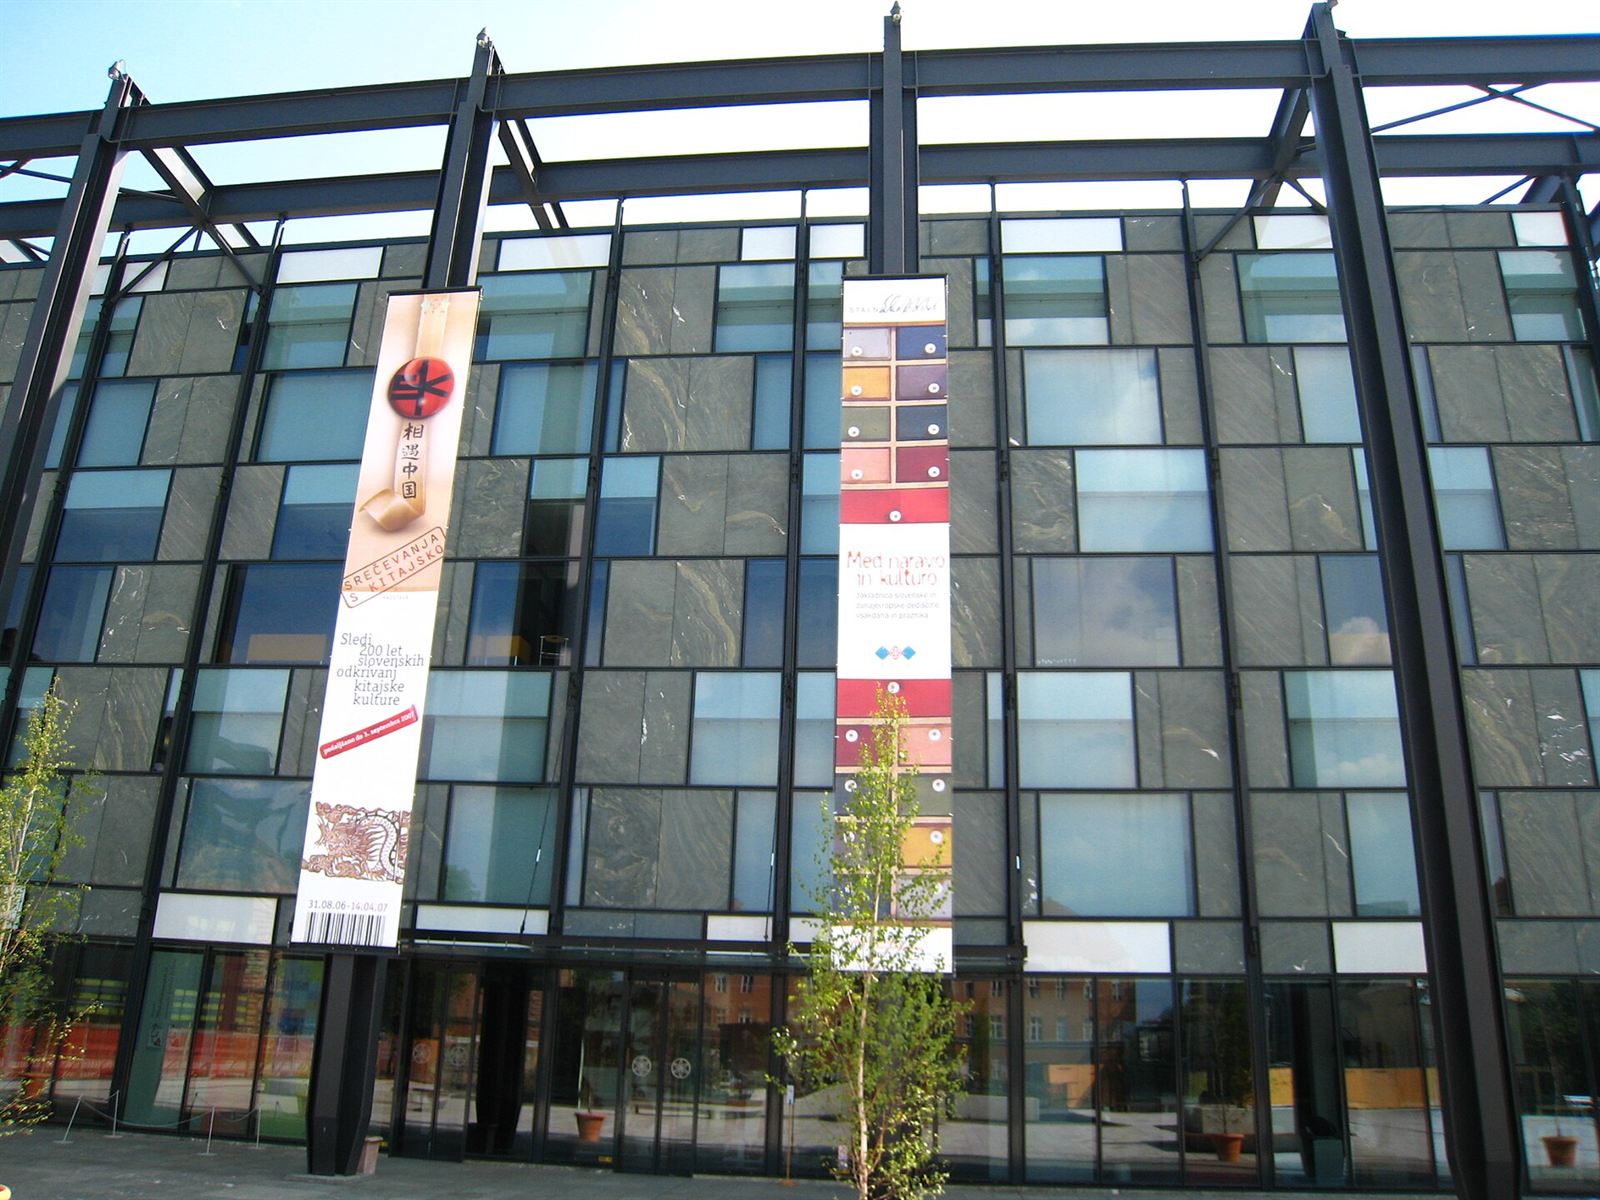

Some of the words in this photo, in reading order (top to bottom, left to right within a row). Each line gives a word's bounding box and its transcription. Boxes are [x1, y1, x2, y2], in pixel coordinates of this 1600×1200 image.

[401, 422, 424, 499] 相遇中国
[344, 534, 438, 590] SREČEVANJA
[847, 551, 882, 568] Med
[889, 556, 945, 568] naravo
[349, 592, 359, 603] S
[368, 544, 444, 592] KITAJSKO
[857, 571, 871, 585] in
[880, 569, 937, 585] kulturo
[340, 632, 373, 645] Sledi
[359, 644, 383, 656] 200
[387, 643, 403, 656] let
[358, 654, 424, 667] slovenskih
[336, 665, 397, 680] odkrivanj
[354, 679, 405, 695] kitajske
[353, 692, 401, 706] kulture
[400, 711, 415, 722] 2007
